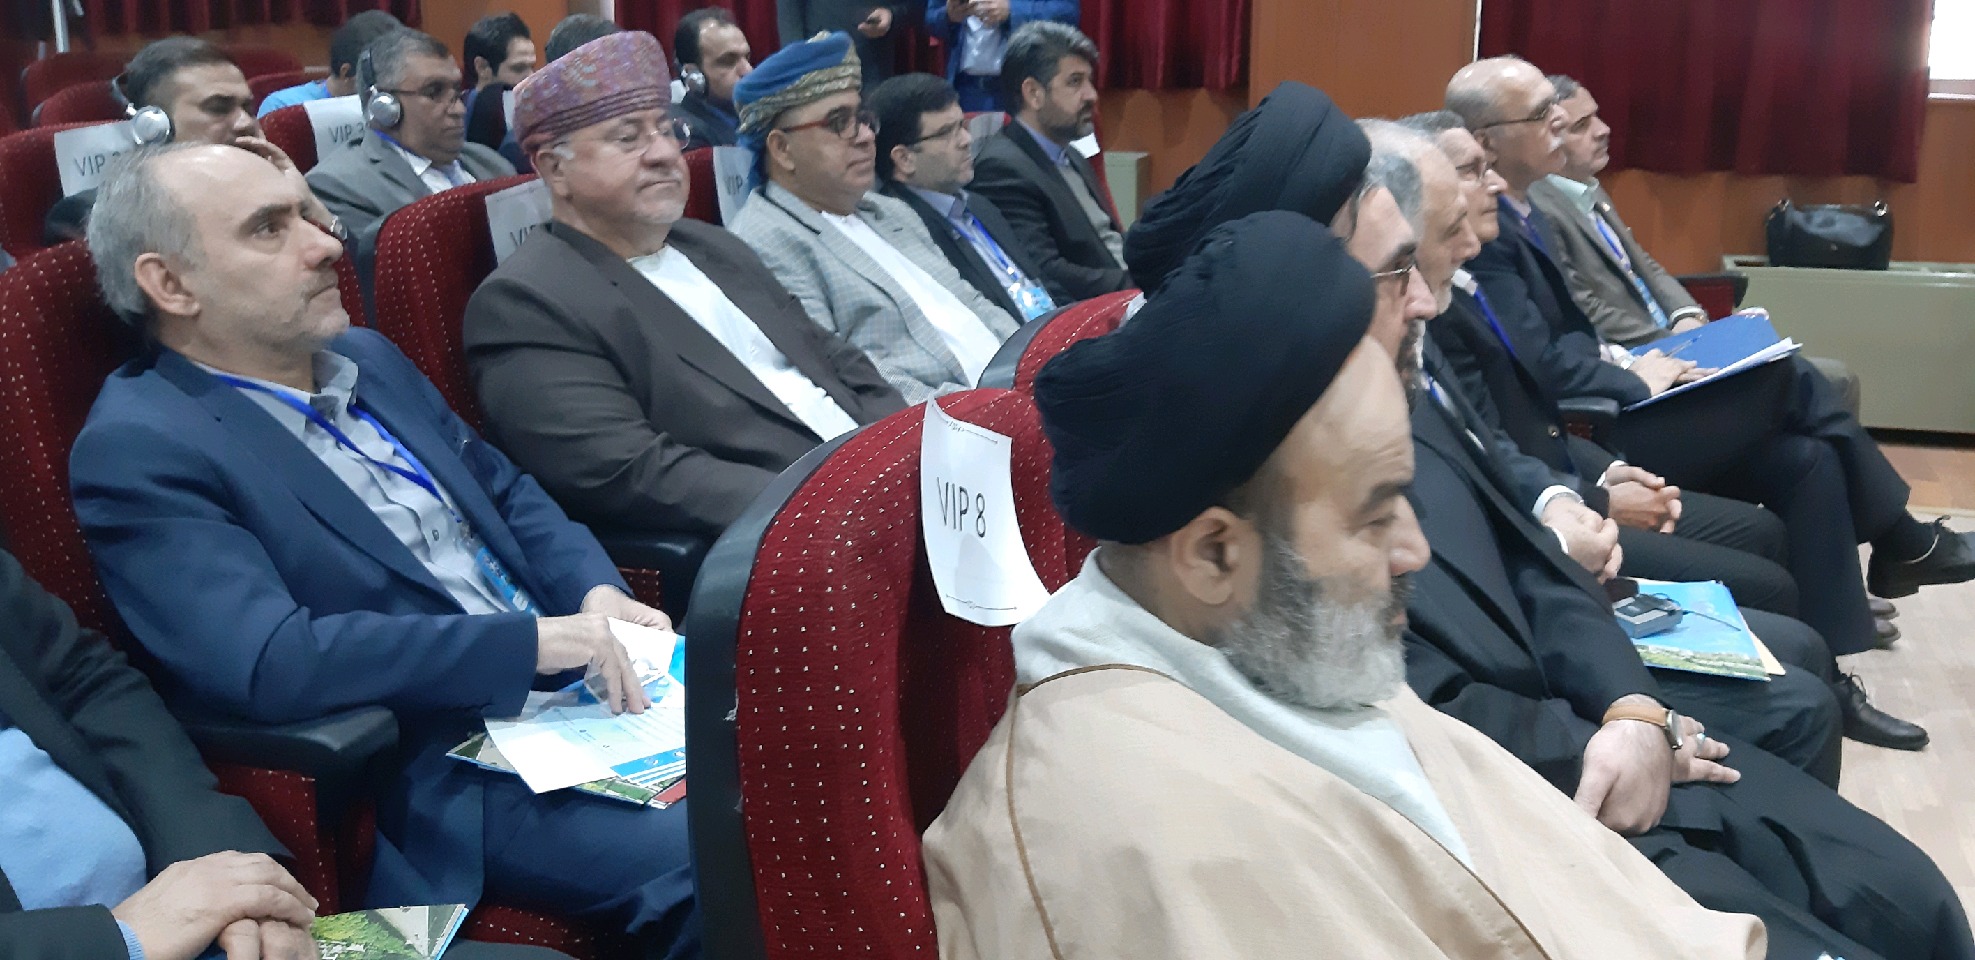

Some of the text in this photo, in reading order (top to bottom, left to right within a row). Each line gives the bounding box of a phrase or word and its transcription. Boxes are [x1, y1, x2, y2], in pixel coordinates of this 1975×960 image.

[328, 123, 352, 143] VIP
[73, 153, 106, 177] VIP
[723, 174, 743, 196] VIP
[936, 476, 986, 538] VIP 8
